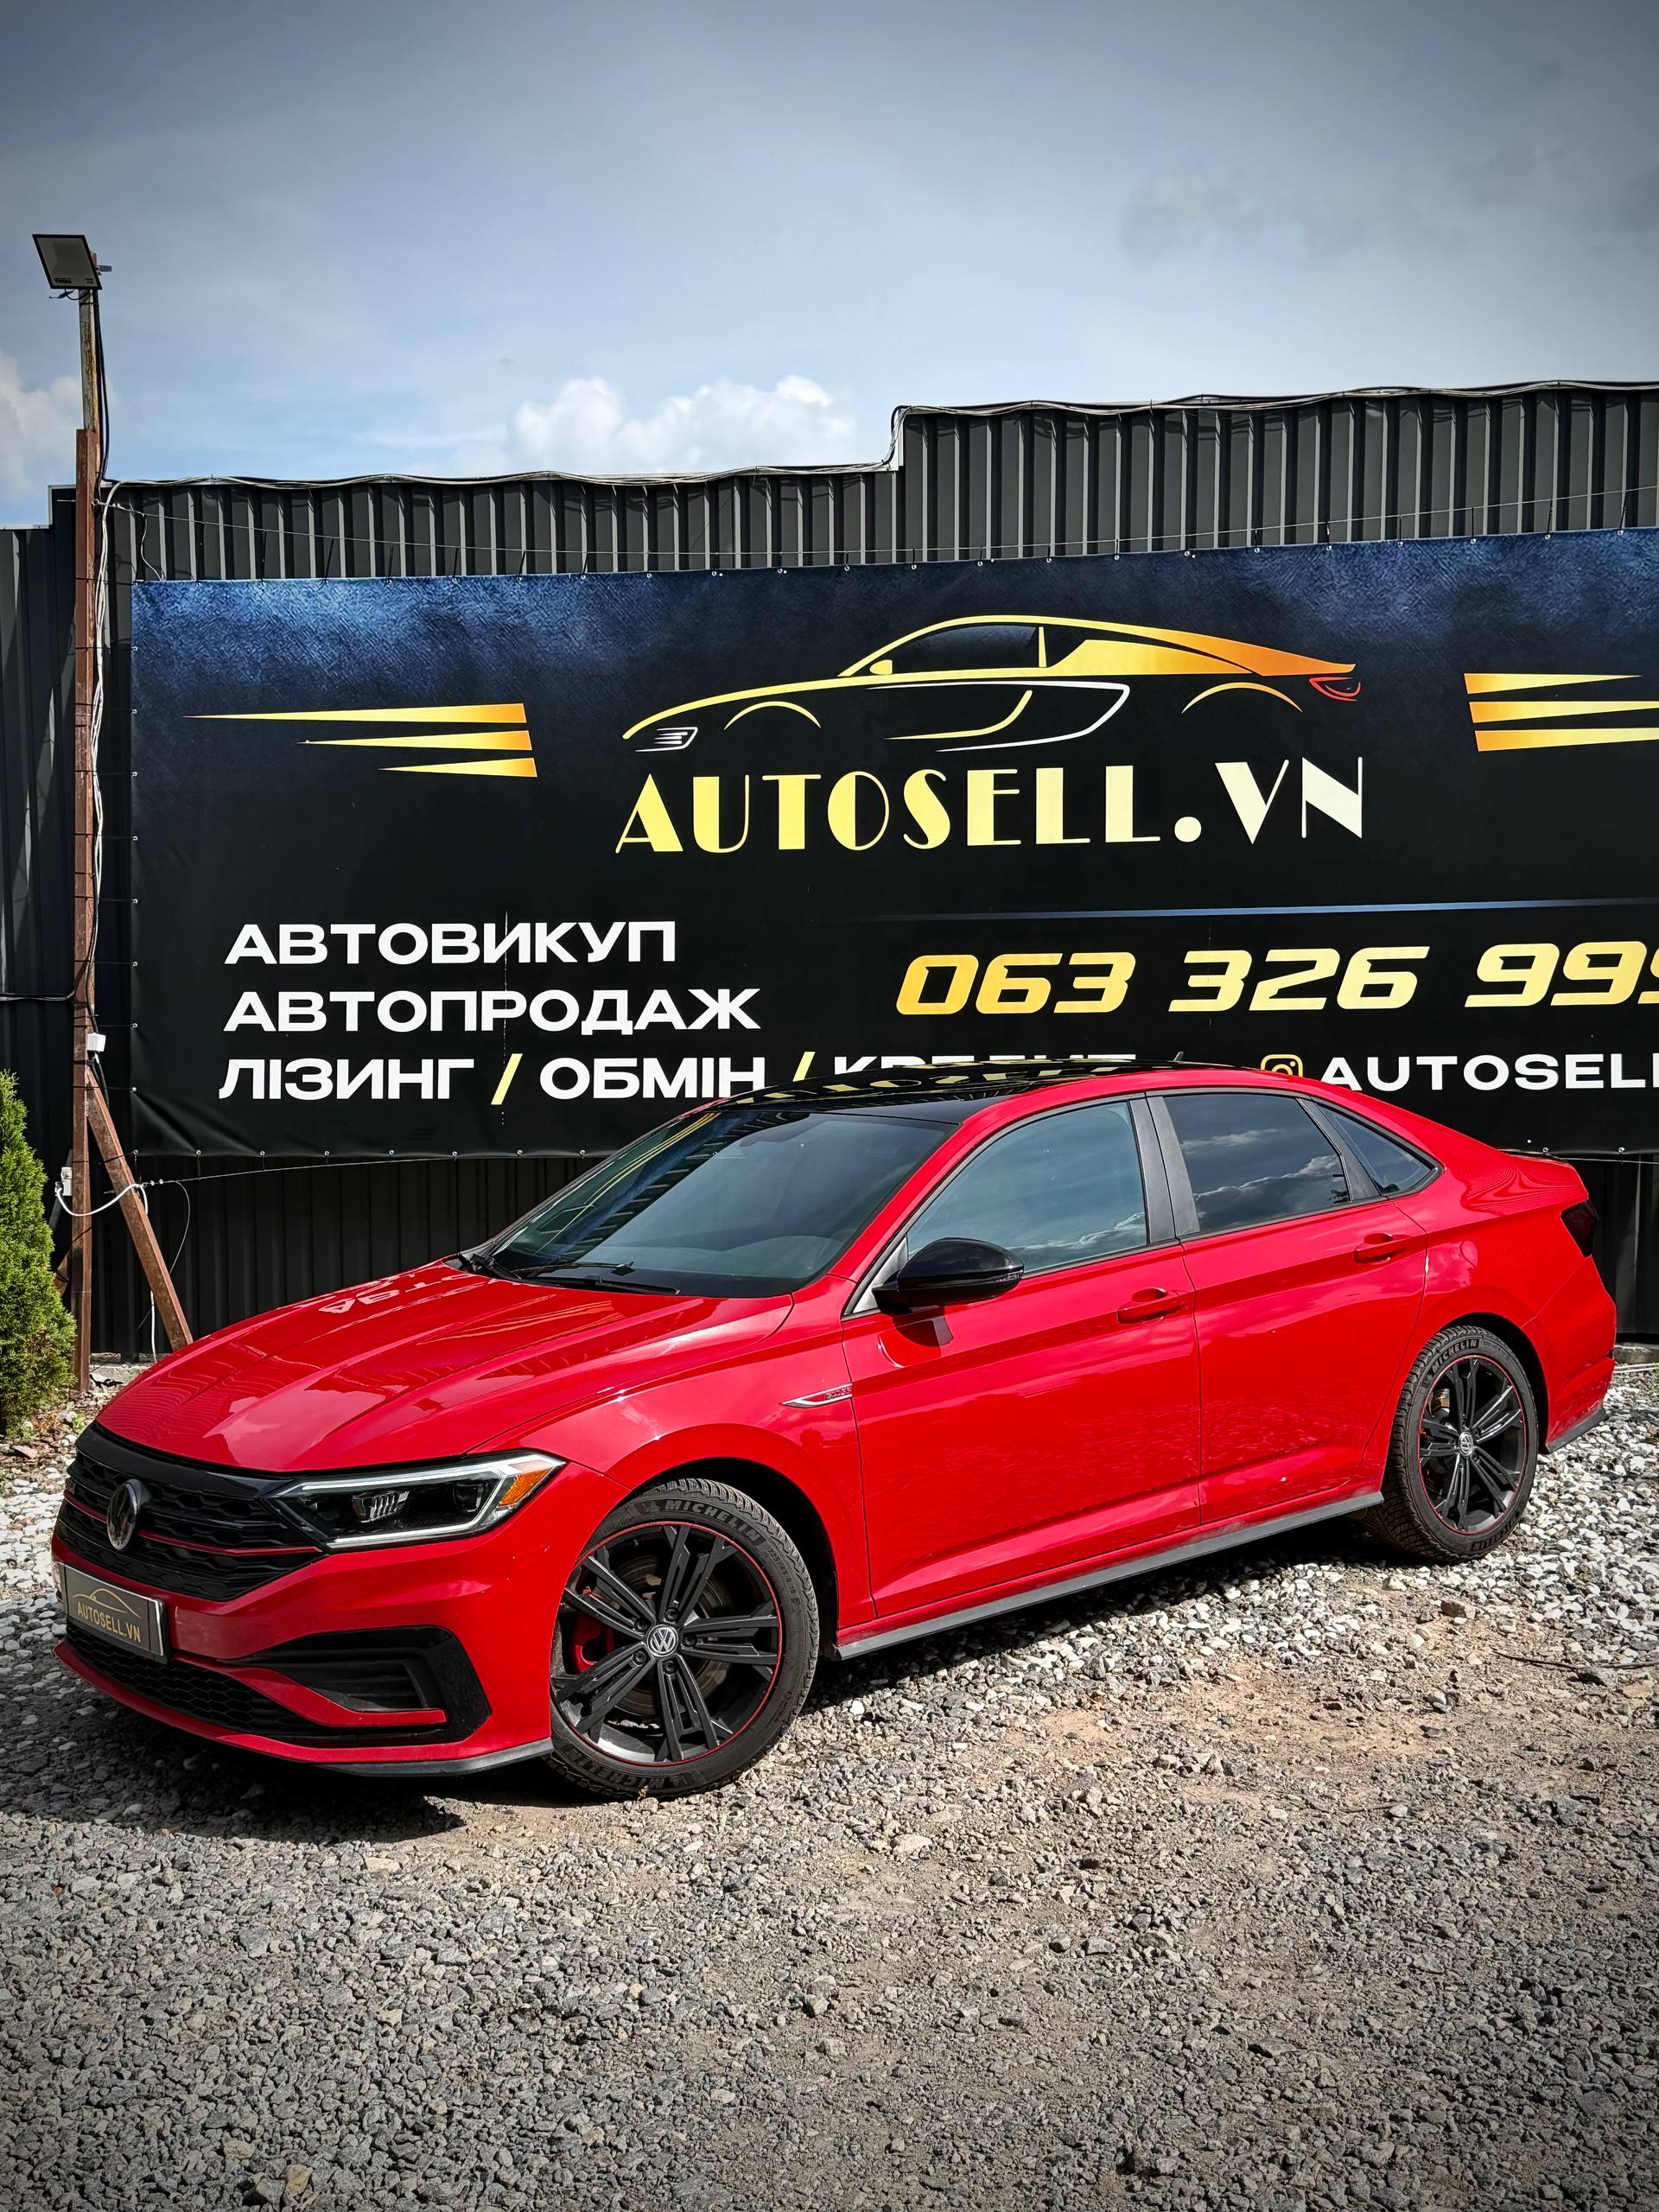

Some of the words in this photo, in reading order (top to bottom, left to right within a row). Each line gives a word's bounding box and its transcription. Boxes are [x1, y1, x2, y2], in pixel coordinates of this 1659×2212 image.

[615, 757, 1363, 854] AUTOSELL.VN
[225, 920, 676, 965] АВТОВИКУП
[896, 952, 1136, 1015] 063
[1168, 946, 1431, 1013] 326
[1465, 941, 1659, 1007] 99
[224, 988, 761, 1036] АВТОПРОДАЖ
[219, 1058, 474, 1101] ЛІЗИНГ
[540, 1057, 766, 1100] ОБМІН
[1321, 1053, 1659, 1092] AUTOSEL
[1432, 1339, 1478, 1373] MICHELIN
[664, 1499, 762, 1542] MICHELIN
[77, 1601, 141, 1643] AUTOSELL.VN
